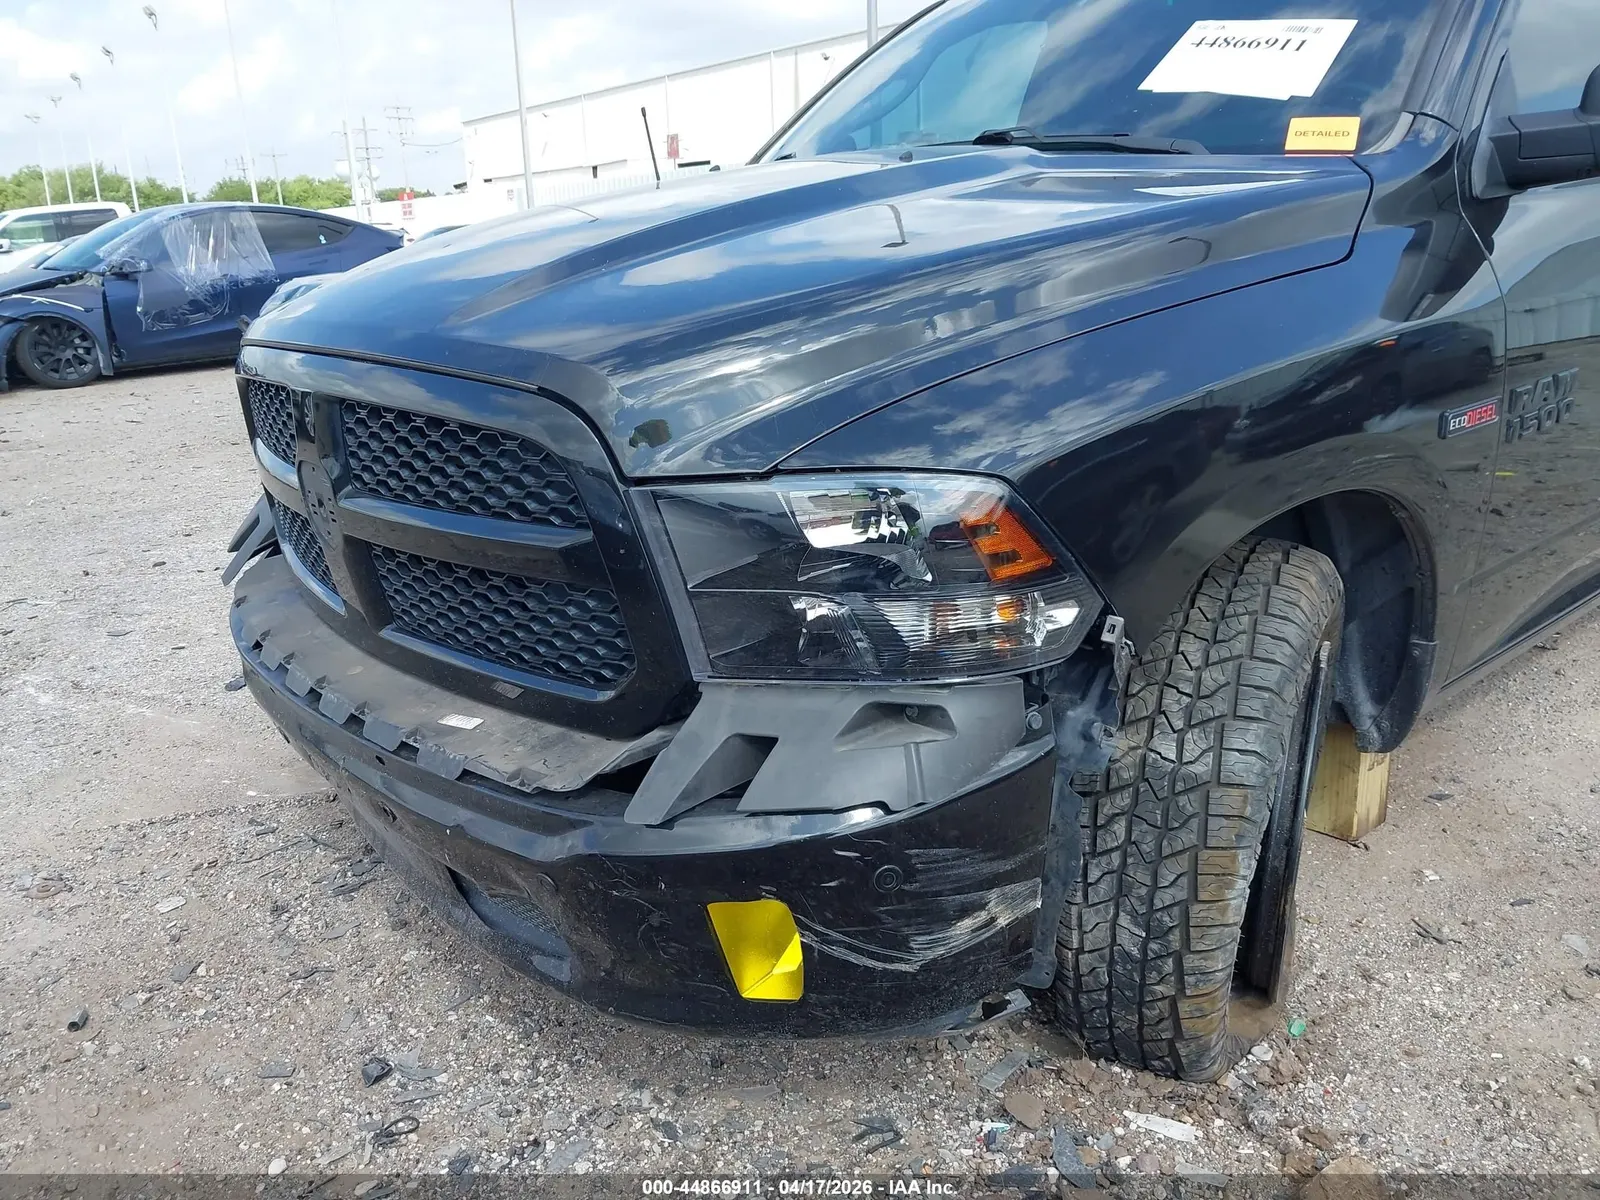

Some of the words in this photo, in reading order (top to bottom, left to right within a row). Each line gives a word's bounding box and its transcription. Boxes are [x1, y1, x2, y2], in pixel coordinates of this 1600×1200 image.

[1191, 36, 1307, 51] 44866911
[1294, 129, 1350, 138] DETAILED
[1505, 397, 1575, 443] 1500
